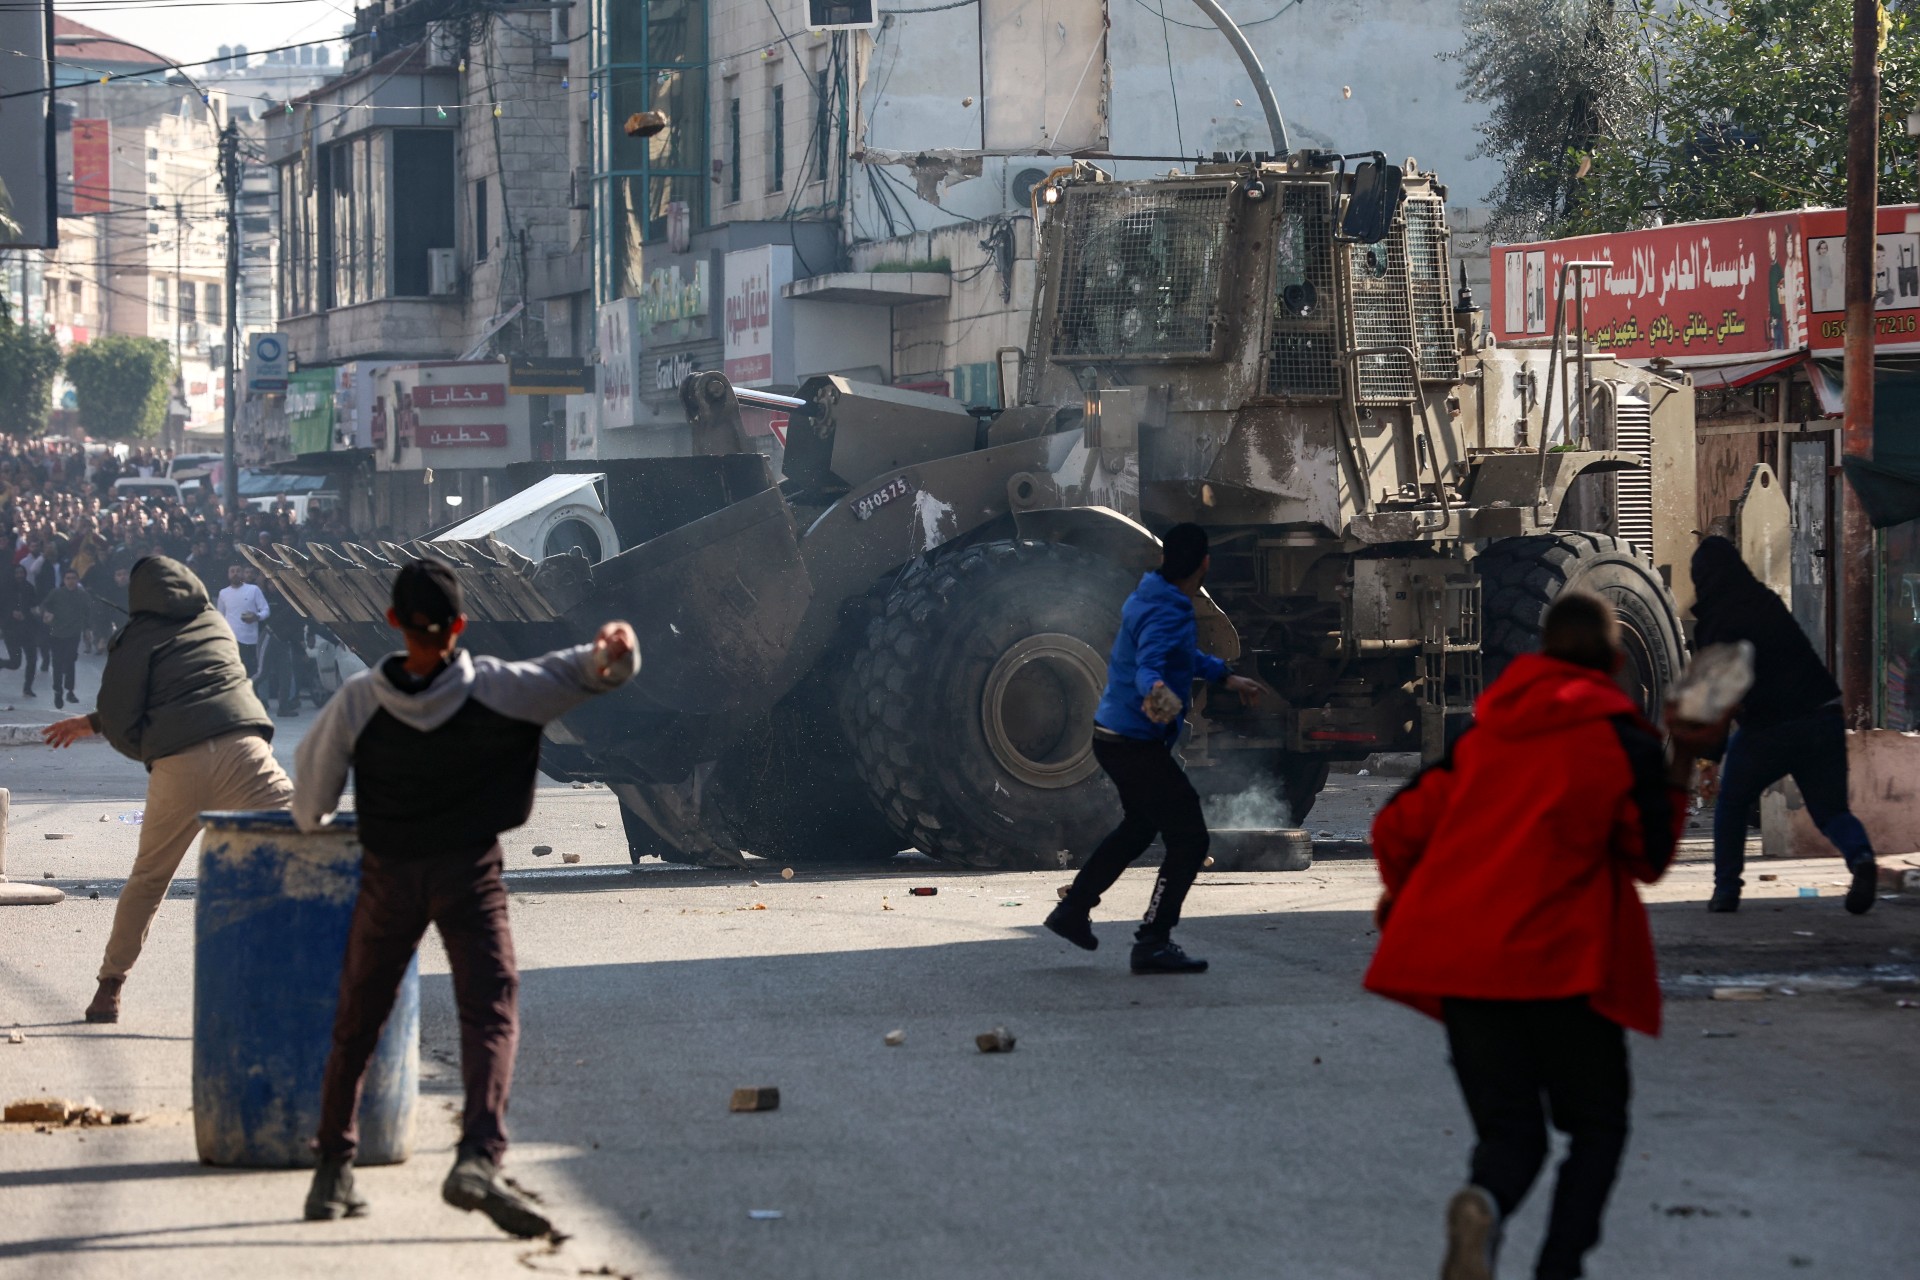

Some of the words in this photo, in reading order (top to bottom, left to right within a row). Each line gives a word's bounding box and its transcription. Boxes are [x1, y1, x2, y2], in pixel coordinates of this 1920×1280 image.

[1658, 240, 1700, 306] العامر
[1702, 236, 1755, 300] مؤسسة
[430, 387, 489, 403] مخابز
[430, 427, 491, 444] حطين
